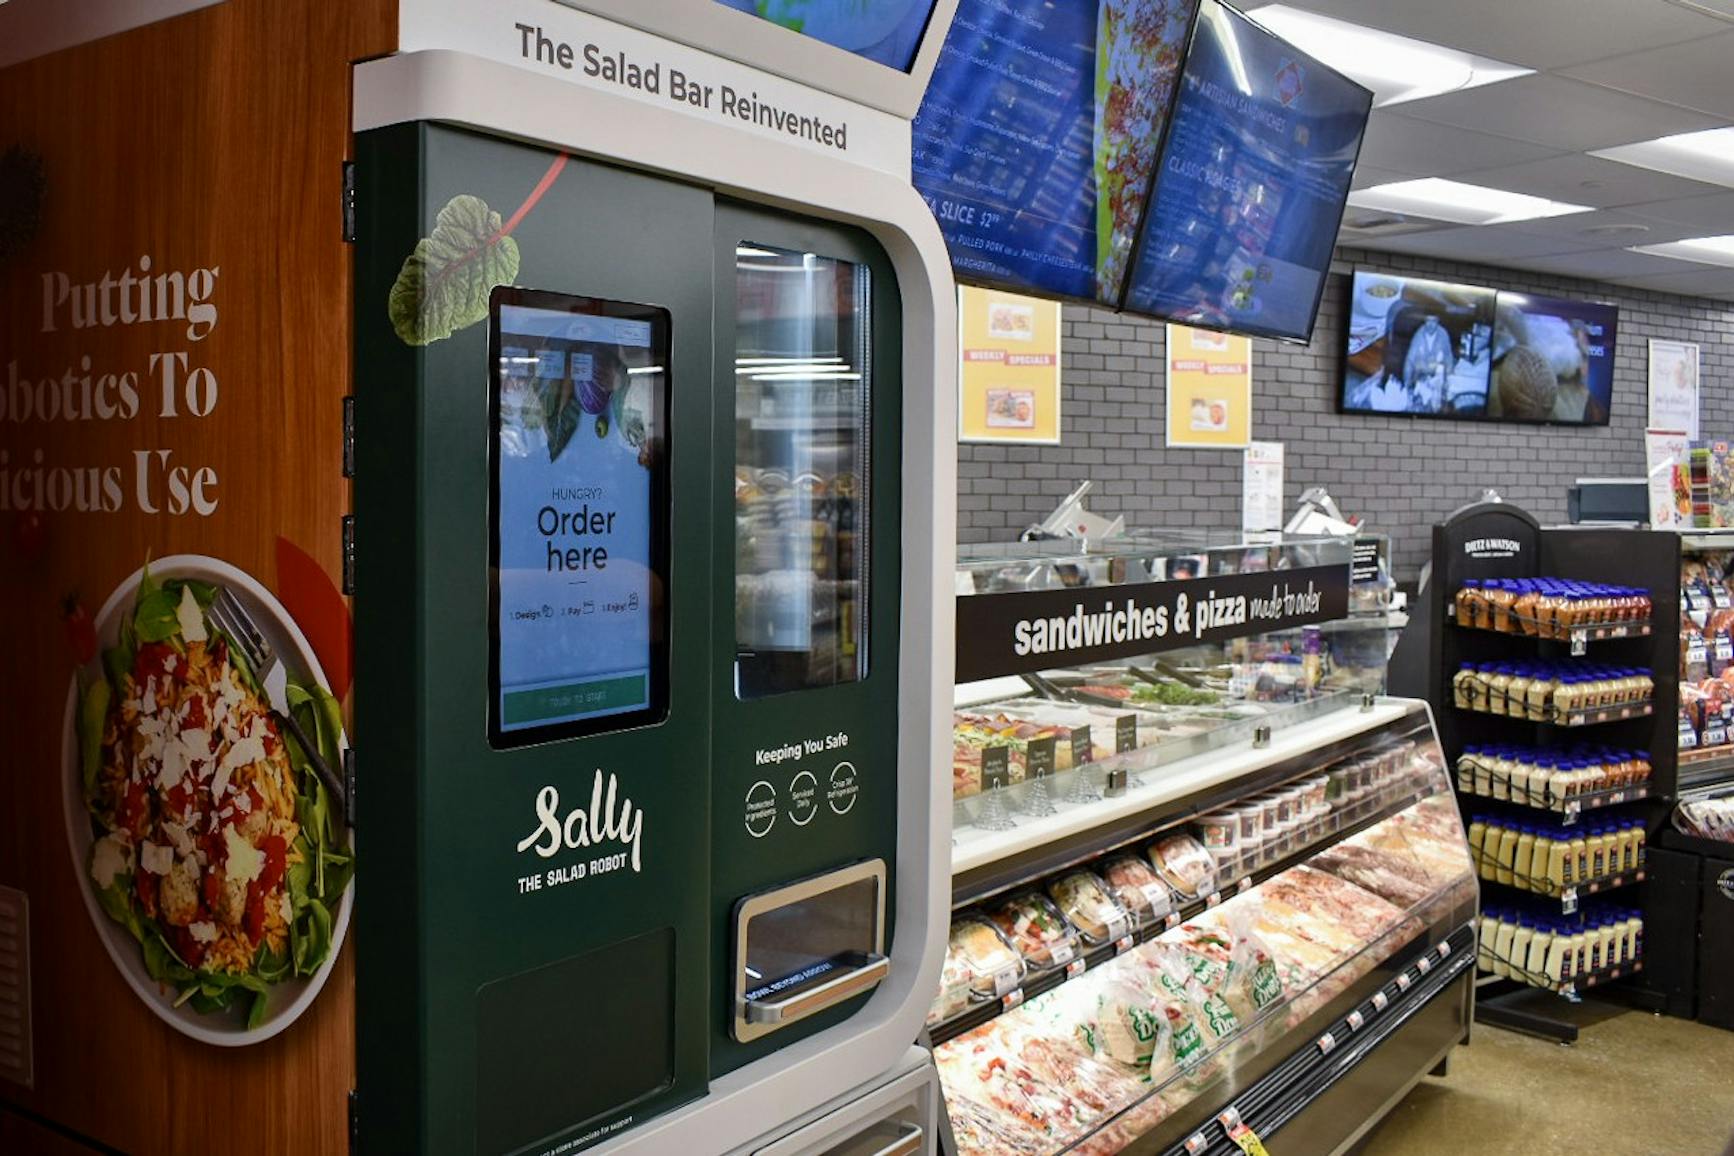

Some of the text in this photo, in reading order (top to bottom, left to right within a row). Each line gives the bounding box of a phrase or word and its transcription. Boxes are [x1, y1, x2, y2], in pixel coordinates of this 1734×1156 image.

[515, 22, 847, 151] The Salad Bar Reinvented
[939, 201, 975, 224] SLICE
[41, 254, 219, 341] Putting
[969, 351, 1051, 366] WEEKLY SPECIALS
[0, 352, 218, 423] botics To
[133, 449, 218, 516] Use
[552, 487, 602, 501] HUNGRY?
[537, 504, 616, 537] Order
[547, 541, 608, 572] here
[1014, 580, 1322, 656] sandwiches & pizza made to order
[755, 732, 849, 765] Keeping You Safe
[516, 768, 643, 872] Sally
[517, 853, 627, 894] THE SALAD ROBOT
